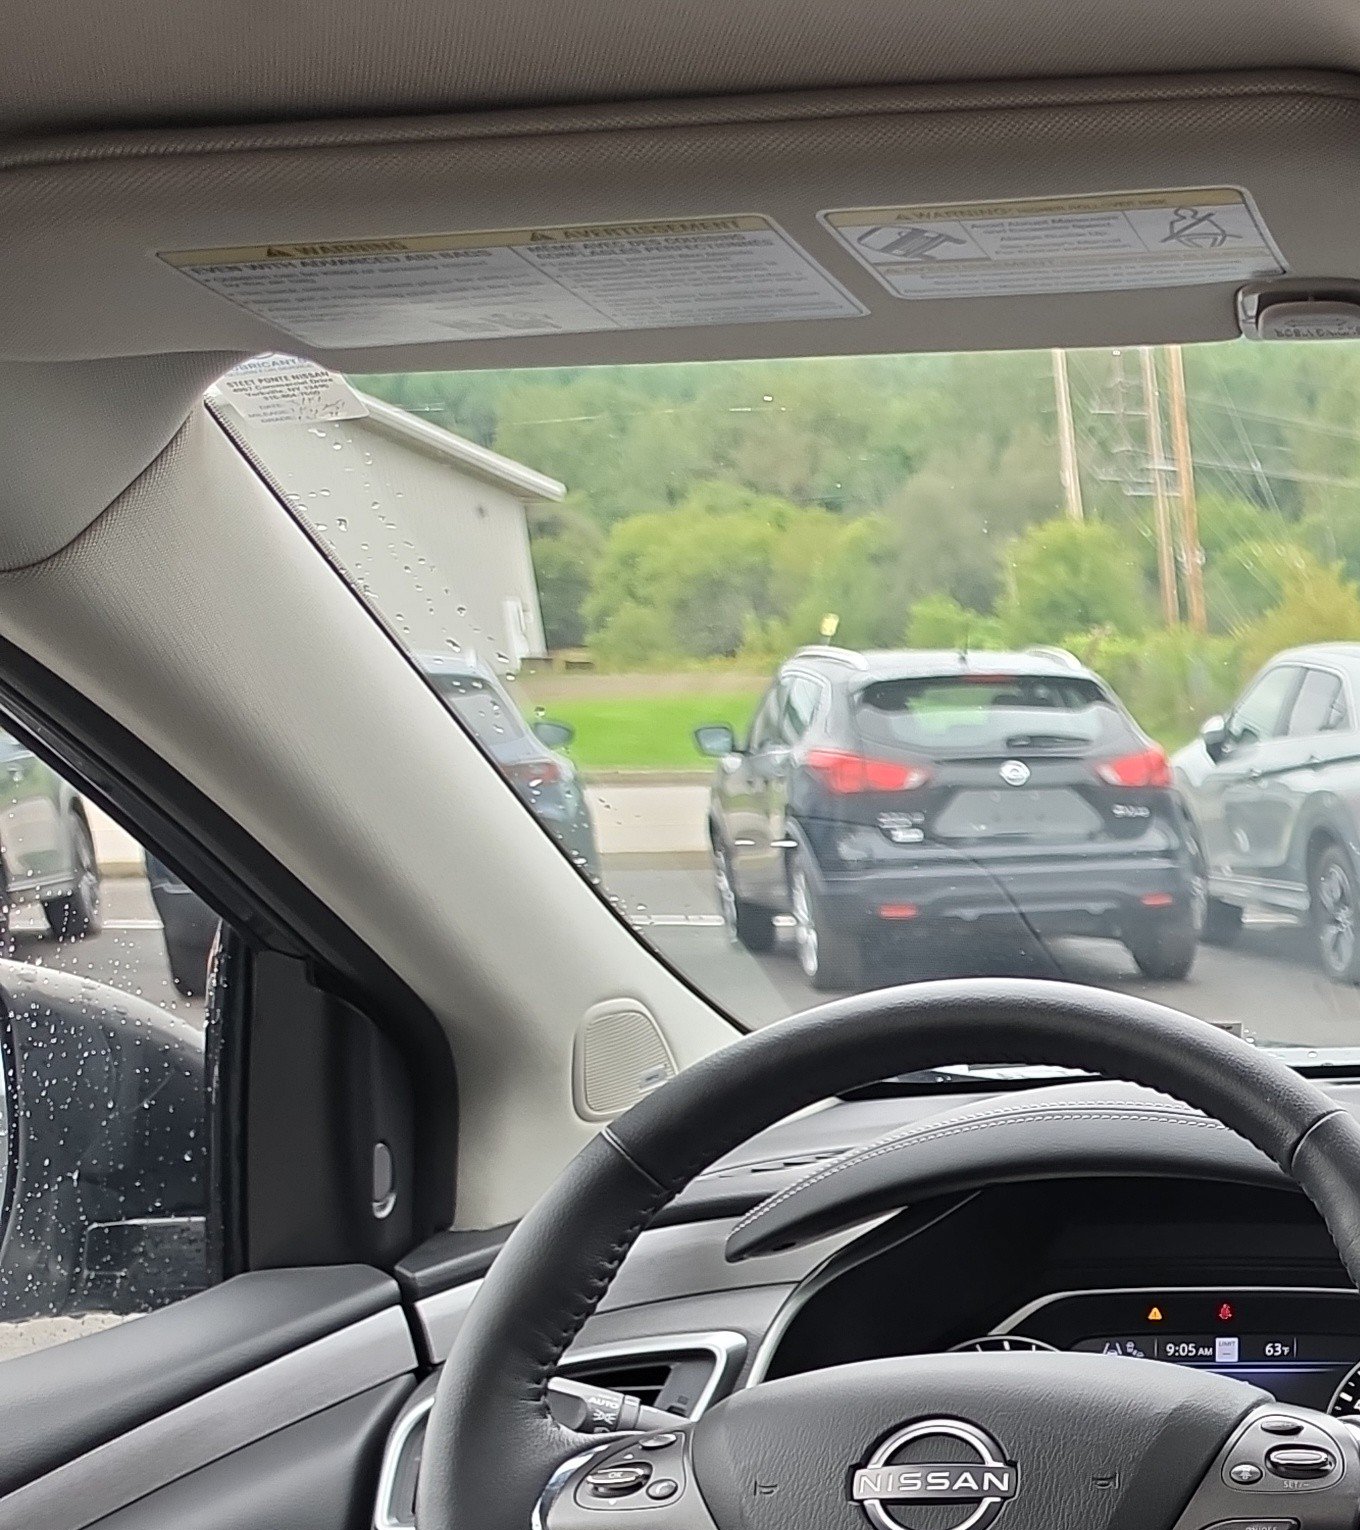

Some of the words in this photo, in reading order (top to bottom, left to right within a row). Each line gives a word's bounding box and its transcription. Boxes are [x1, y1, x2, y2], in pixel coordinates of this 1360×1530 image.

[1166, 1343, 1196, 1356] 9:05
[1198, 1347, 1213, 1356] AM
[608, 1471, 624, 1479] OK
[859, 1471, 1009, 1493] NISSAN
